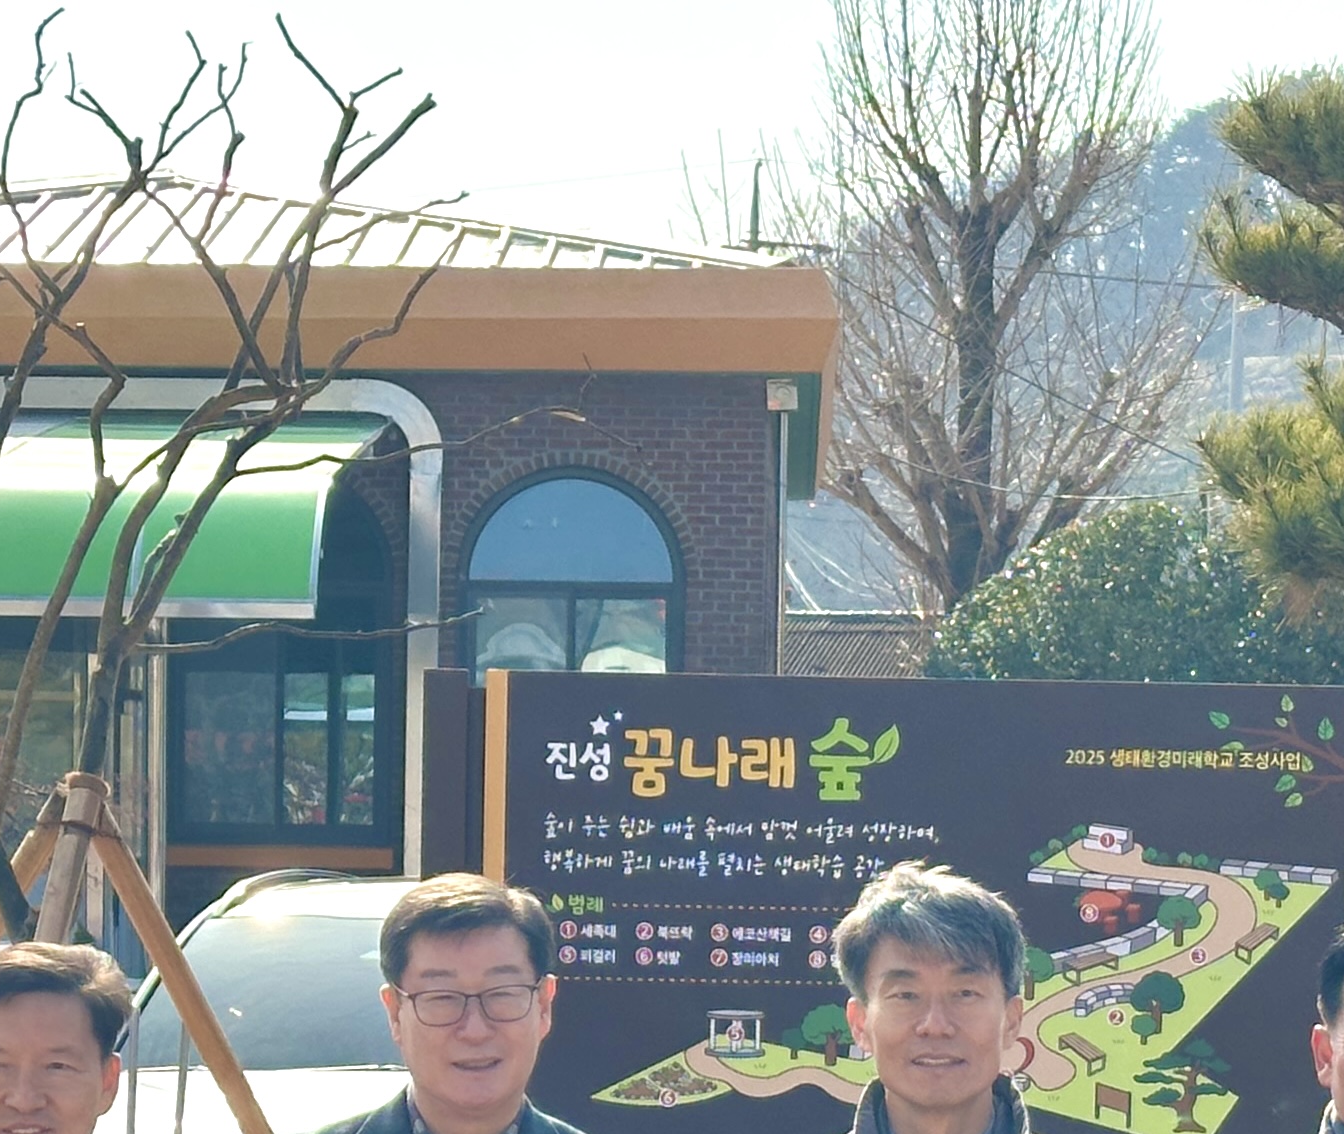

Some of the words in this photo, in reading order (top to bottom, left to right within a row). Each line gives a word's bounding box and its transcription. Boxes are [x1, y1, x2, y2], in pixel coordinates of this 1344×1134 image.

[546, 742, 611, 782] 진성
[623, 728, 796, 798] 꿈나래
[809, 717, 870, 801] 숲
[1065, 749, 1105, 765] 2025
[1109, 749, 1235, 770] 생태환경미래학교
[1238, 751, 1302, 772] 조성사업
[544, 811, 573, 839] 숲이
[582, 814, 610, 838] 주는
[662, 815, 696, 841] 배움
[704, 815, 753, 841] 속에서
[806, 817, 854, 844] 어울려
[543, 849, 613, 874] 행복하게
[621, 850, 651, 875] 꿈의
[659, 850, 710, 877] 나래를
[717, 852, 767, 877] 펼치는
[773, 854, 846, 879] 생태학습
[568, 894, 604, 915] 범례
[732, 926, 792, 942] 에코산책길
[732, 951, 780, 967] 장미아치
